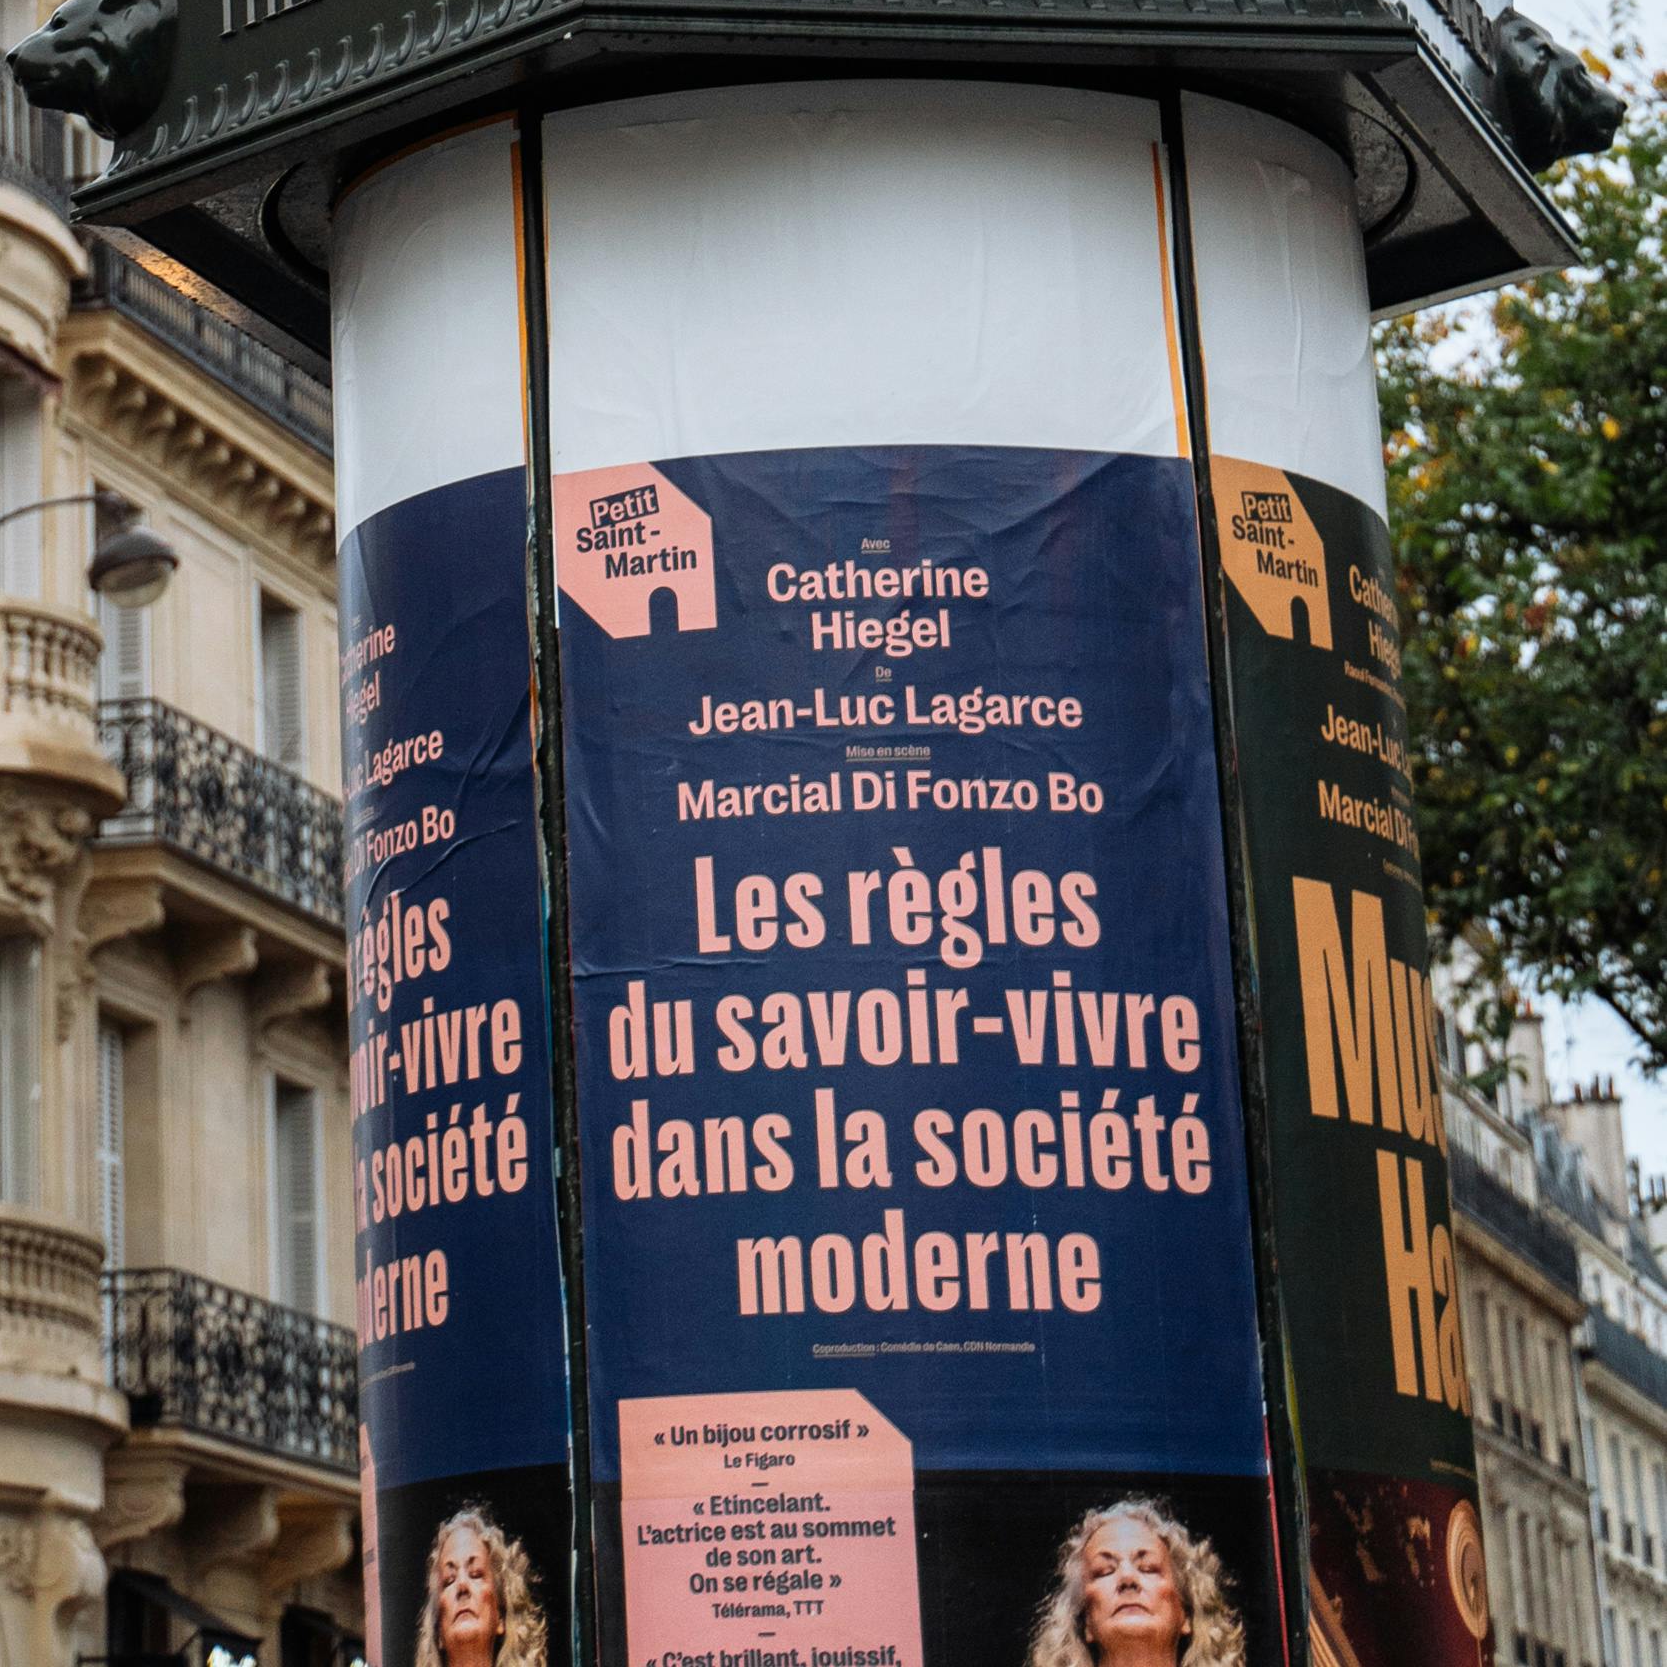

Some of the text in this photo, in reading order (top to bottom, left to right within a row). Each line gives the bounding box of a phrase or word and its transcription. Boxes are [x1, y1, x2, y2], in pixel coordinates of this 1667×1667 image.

[592, 488, 658, 527] Petit
[1243, 495, 1291, 521] Petit
[604, 545, 697, 579] Martin
[860, 537, 891, 551] Avec
[766, 559, 990, 602] Catherine
[1256, 549, 1319, 588] Martin
[810, 609, 952, 658] Hiegel
[875, 666, 892, 680] De
[687, 685, 1083, 735] Jean-Luc Lagarce
[365, 729, 444, 786] Lagarce
[845, 743, 932, 759] Mise en scène
[677, 769, 1105, 821] Marcial Di Fonzo Bo
[1317, 779, 1394, 842] Marcial
[365, 819, 418, 866] Fonzo
[421, 804, 456, 845] Bo
[694, 846, 1101, 968] Les règles
[354, 890, 452, 1013] règles
[608, 968, 1202, 1080] du savoir-vivre
[371, 1092, 529, 1224] société
[612, 1088, 1212, 1201] dans la société
[736, 1208, 1103, 1316] moderne
[670, 1425, 698, 1445] Un
[702, 1422, 756, 1449] bijou
[760, 1419, 851, 1443] corrosif
[723, 1451, 796, 1470] Le Figaro
[709, 1493, 831, 1517] Etincelant.
[637, 1516, 896, 1546] L'actrice est au sommet
[705, 1545, 822, 1569] de son art.
[689, 1573, 719, 1595] On
[722, 1575, 748, 1593] se
[752, 1570, 823, 1595] régale
[712, 1599, 824, 1619] Télérama, TTT
